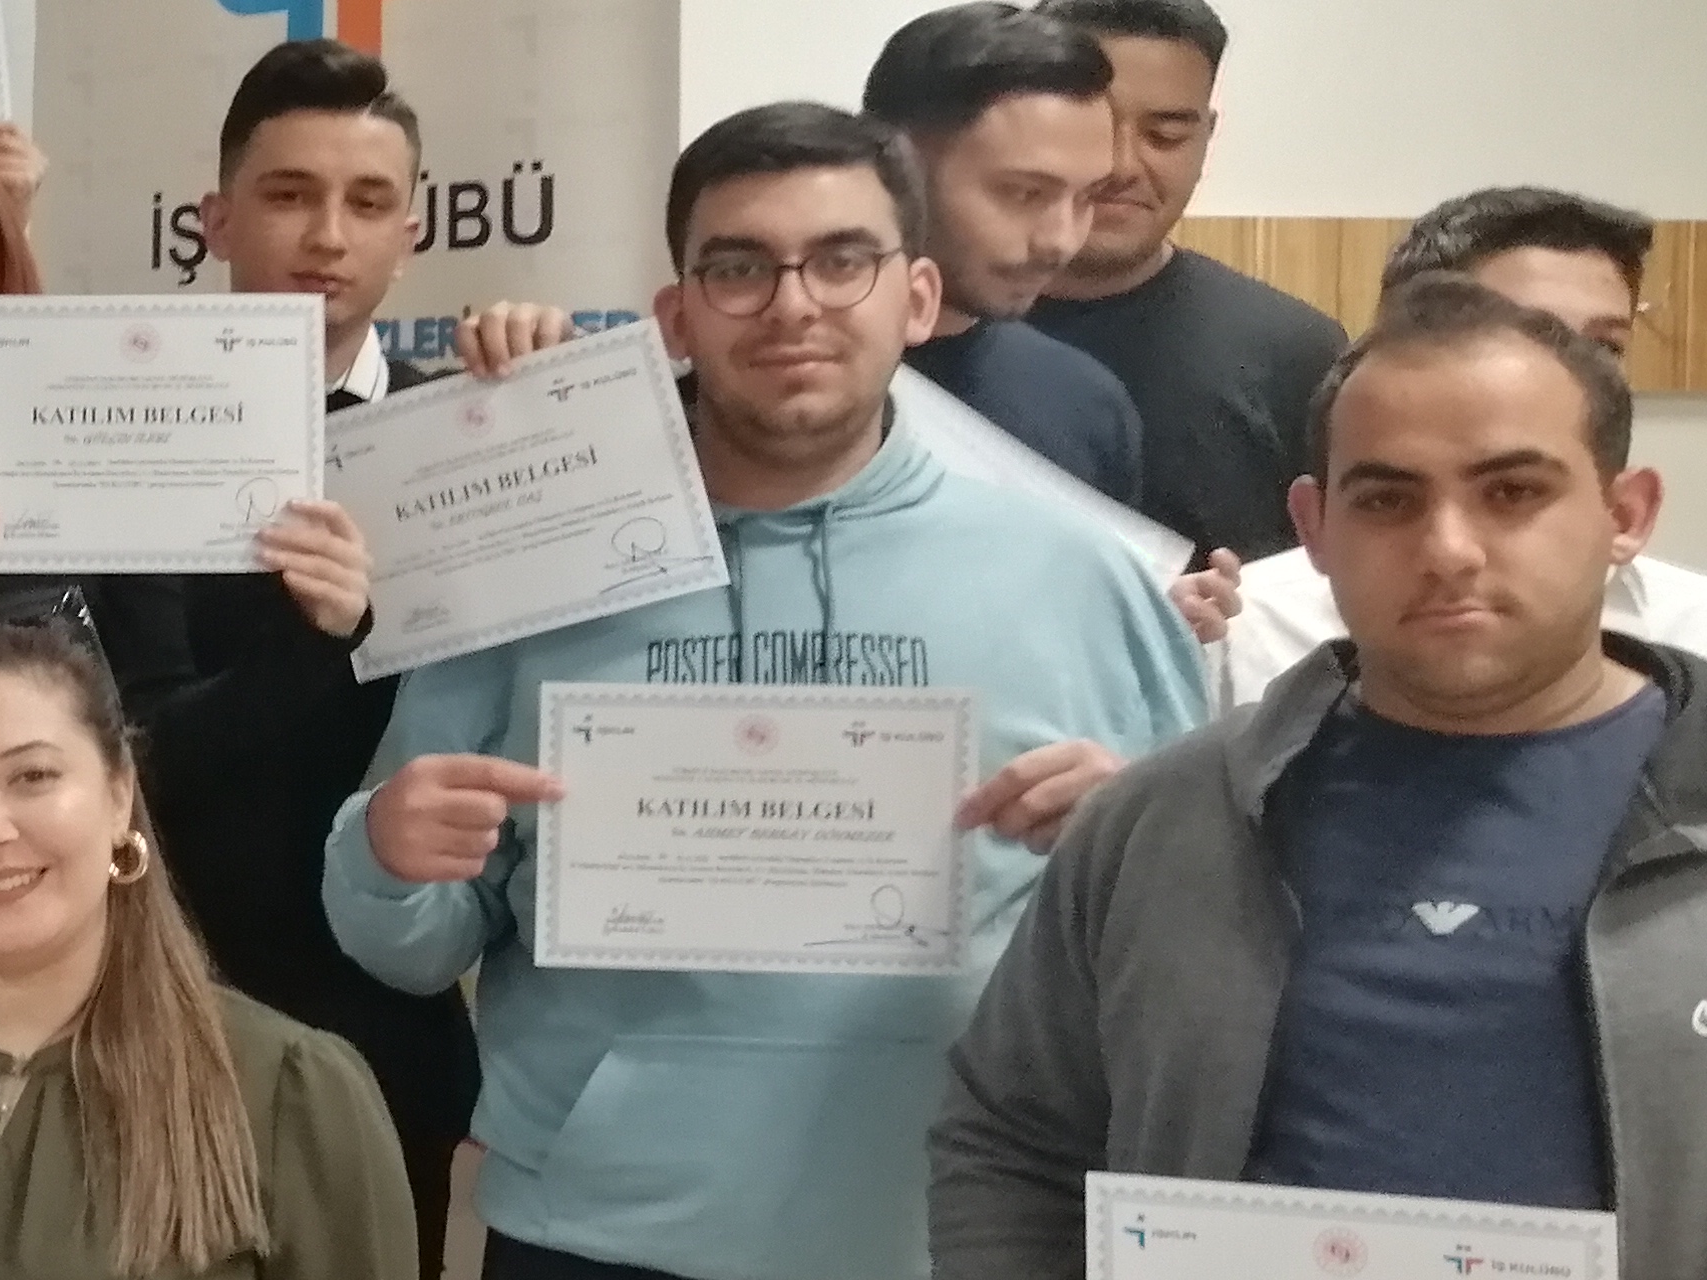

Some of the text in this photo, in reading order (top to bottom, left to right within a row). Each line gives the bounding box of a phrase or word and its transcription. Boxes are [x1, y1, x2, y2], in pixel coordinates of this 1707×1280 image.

[32, 401, 244, 426] KATILIM BELGESİ
[395, 477, 491, 521] KATILIM
[498, 444, 598, 493] BELGESİ
[646, 628, 929, 687] POSTER COMPRESSED
[637, 797, 875, 821] KATILIM BELGESİ
